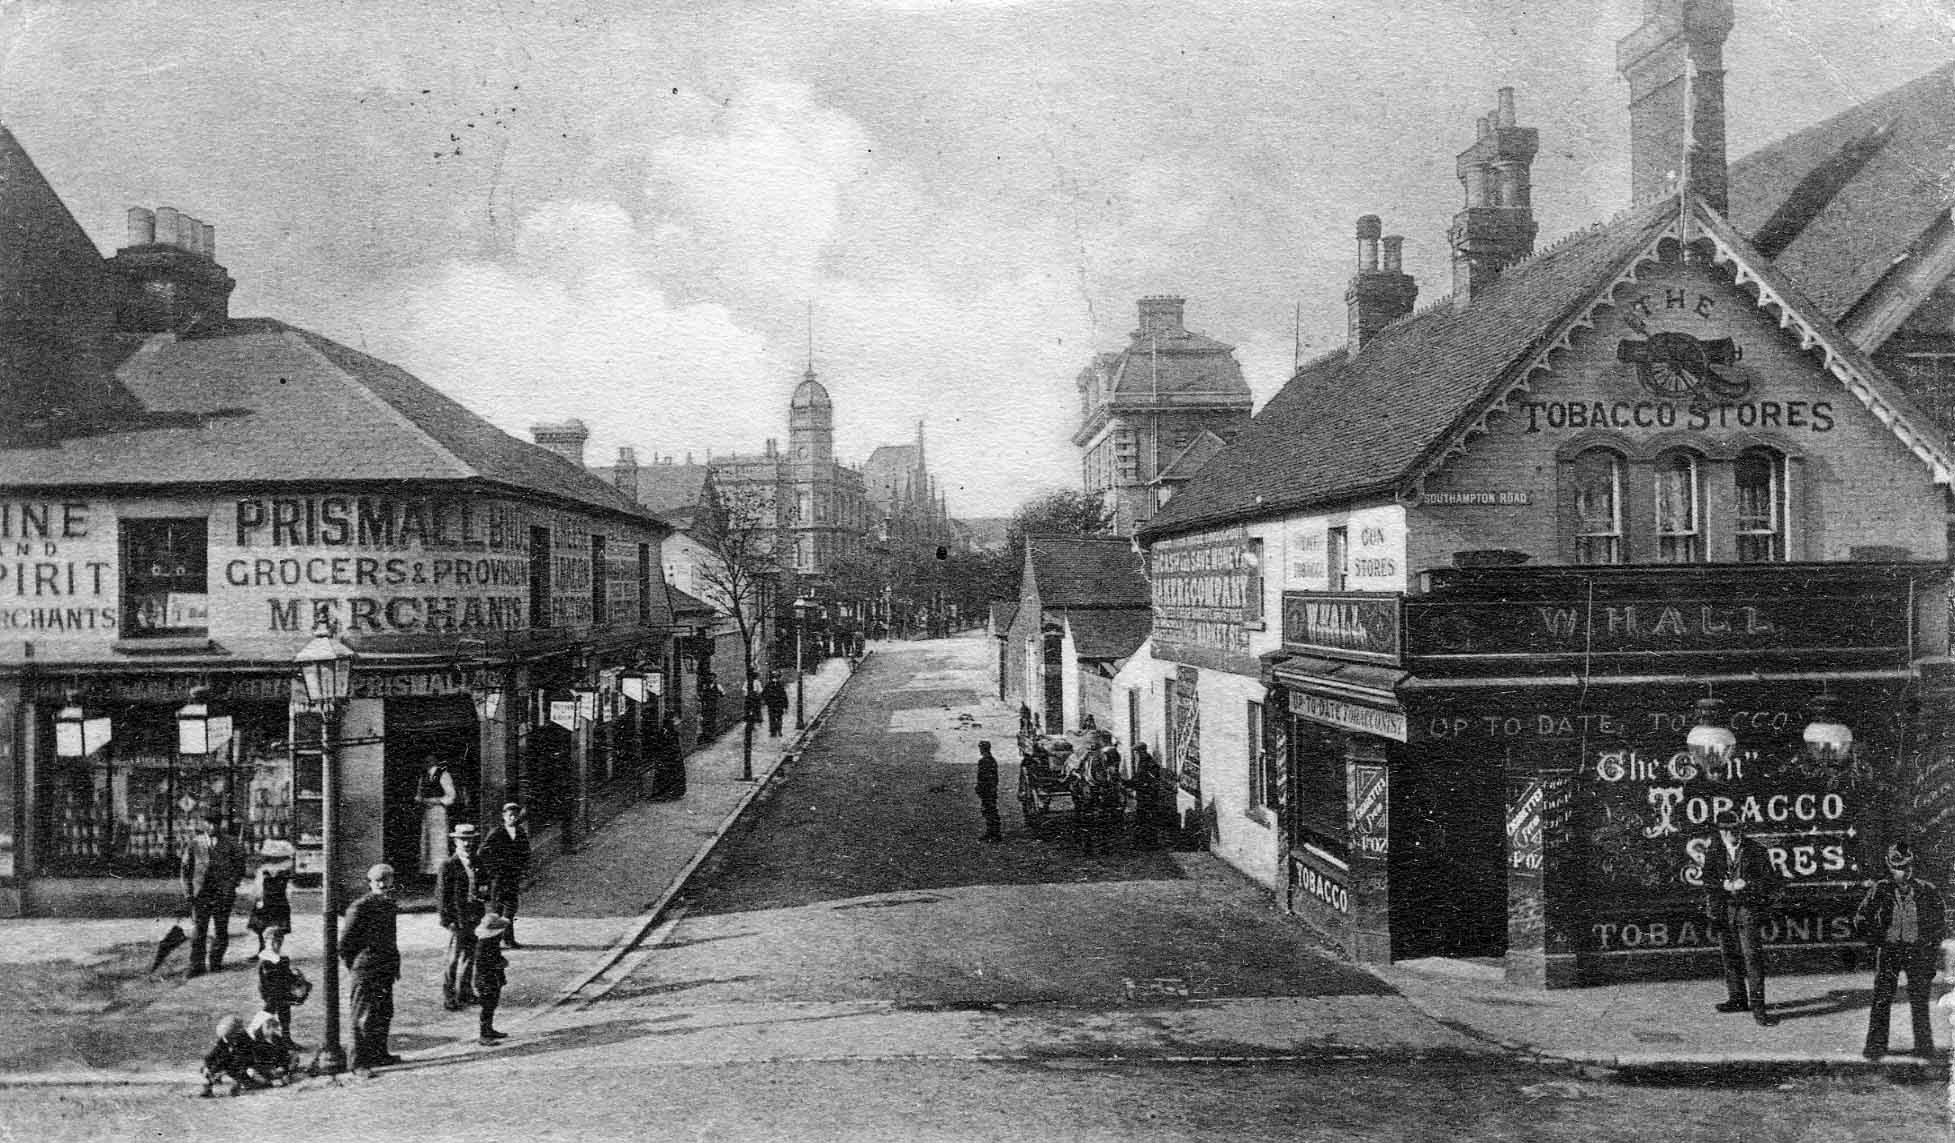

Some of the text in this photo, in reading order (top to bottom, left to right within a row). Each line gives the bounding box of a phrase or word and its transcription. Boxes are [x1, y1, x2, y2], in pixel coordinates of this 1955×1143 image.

[1628, 289, 1714, 318] THE
[1519, 400, 1835, 433] TOBACCO STORES
[1423, 492, 1527, 504] SOUTHAMPTON ROAD
[236, 497, 486, 549] PRISMALL
[0, 542, 57, 558] ND
[225, 558, 406, 587] GROCERS
[411, 561, 427, 585] &
[1353, 558, 1396, 577] STORES
[266, 596, 523, 633] MERCHANTS
[1430, 717, 1469, 738] UP
[1481, 715, 1521, 737] TO
[1679, 837, 1858, 886] SRES.
[1296, 861, 1348, 914] TOBACCO
